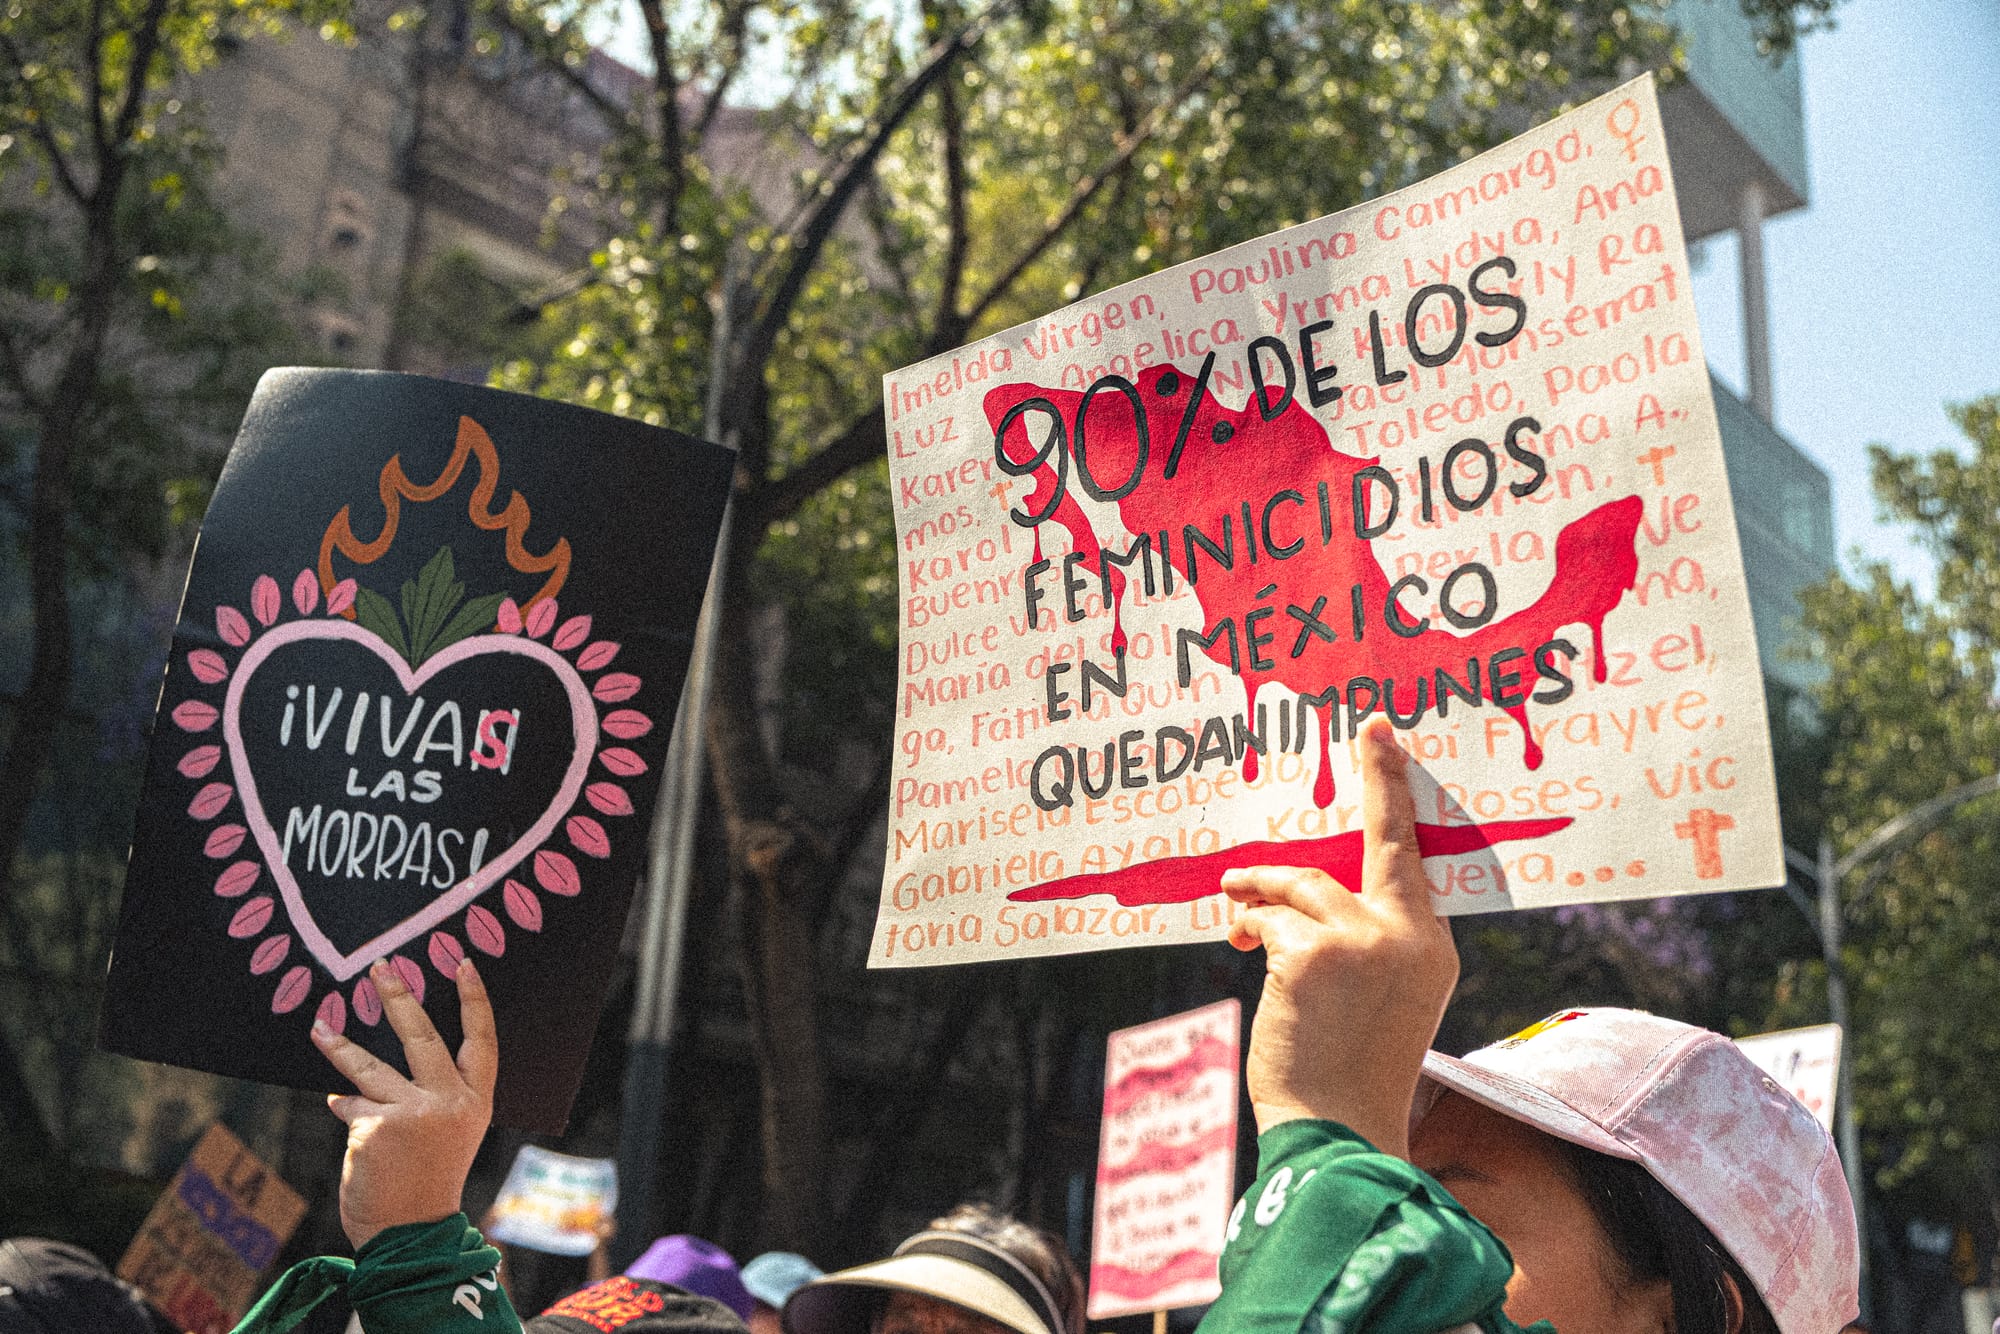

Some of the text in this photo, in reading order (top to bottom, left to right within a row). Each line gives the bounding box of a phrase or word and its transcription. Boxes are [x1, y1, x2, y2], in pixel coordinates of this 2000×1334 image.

[1261, 274, 1392, 335] Yrma
[1574, 165, 1665, 224] Ana
[1597, 224, 1665, 276] Ra
[890, 348, 1012, 421] Imelda
[1022, 293, 1165, 361] Virgen,
[1189, 231, 1357, 304] Paulina
[994, 350, 1235, 528] 90%
[1247, 319, 1344, 422] DE
[1368, 256, 1527, 387] LOS
[1345, 332, 1691, 456] Toledo, Paola
[908, 524, 1013, 593] Karol
[1025, 417, 1547, 630] FEMINICIDIOS
[906, 626, 999, 676] Dulce
[1178, 562, 1498, 689] MÉXICO
[905, 661, 1011, 719] María
[1029, 703, 1268, 812] QUEDAN
[1279, 638, 1581, 755] IMPUNES
[1046, 645, 1128, 722] EN
[346, 767, 443, 803] LAS
[282, 804, 489, 890] MORRAS!
[892, 850, 1064, 912] Gabriela
